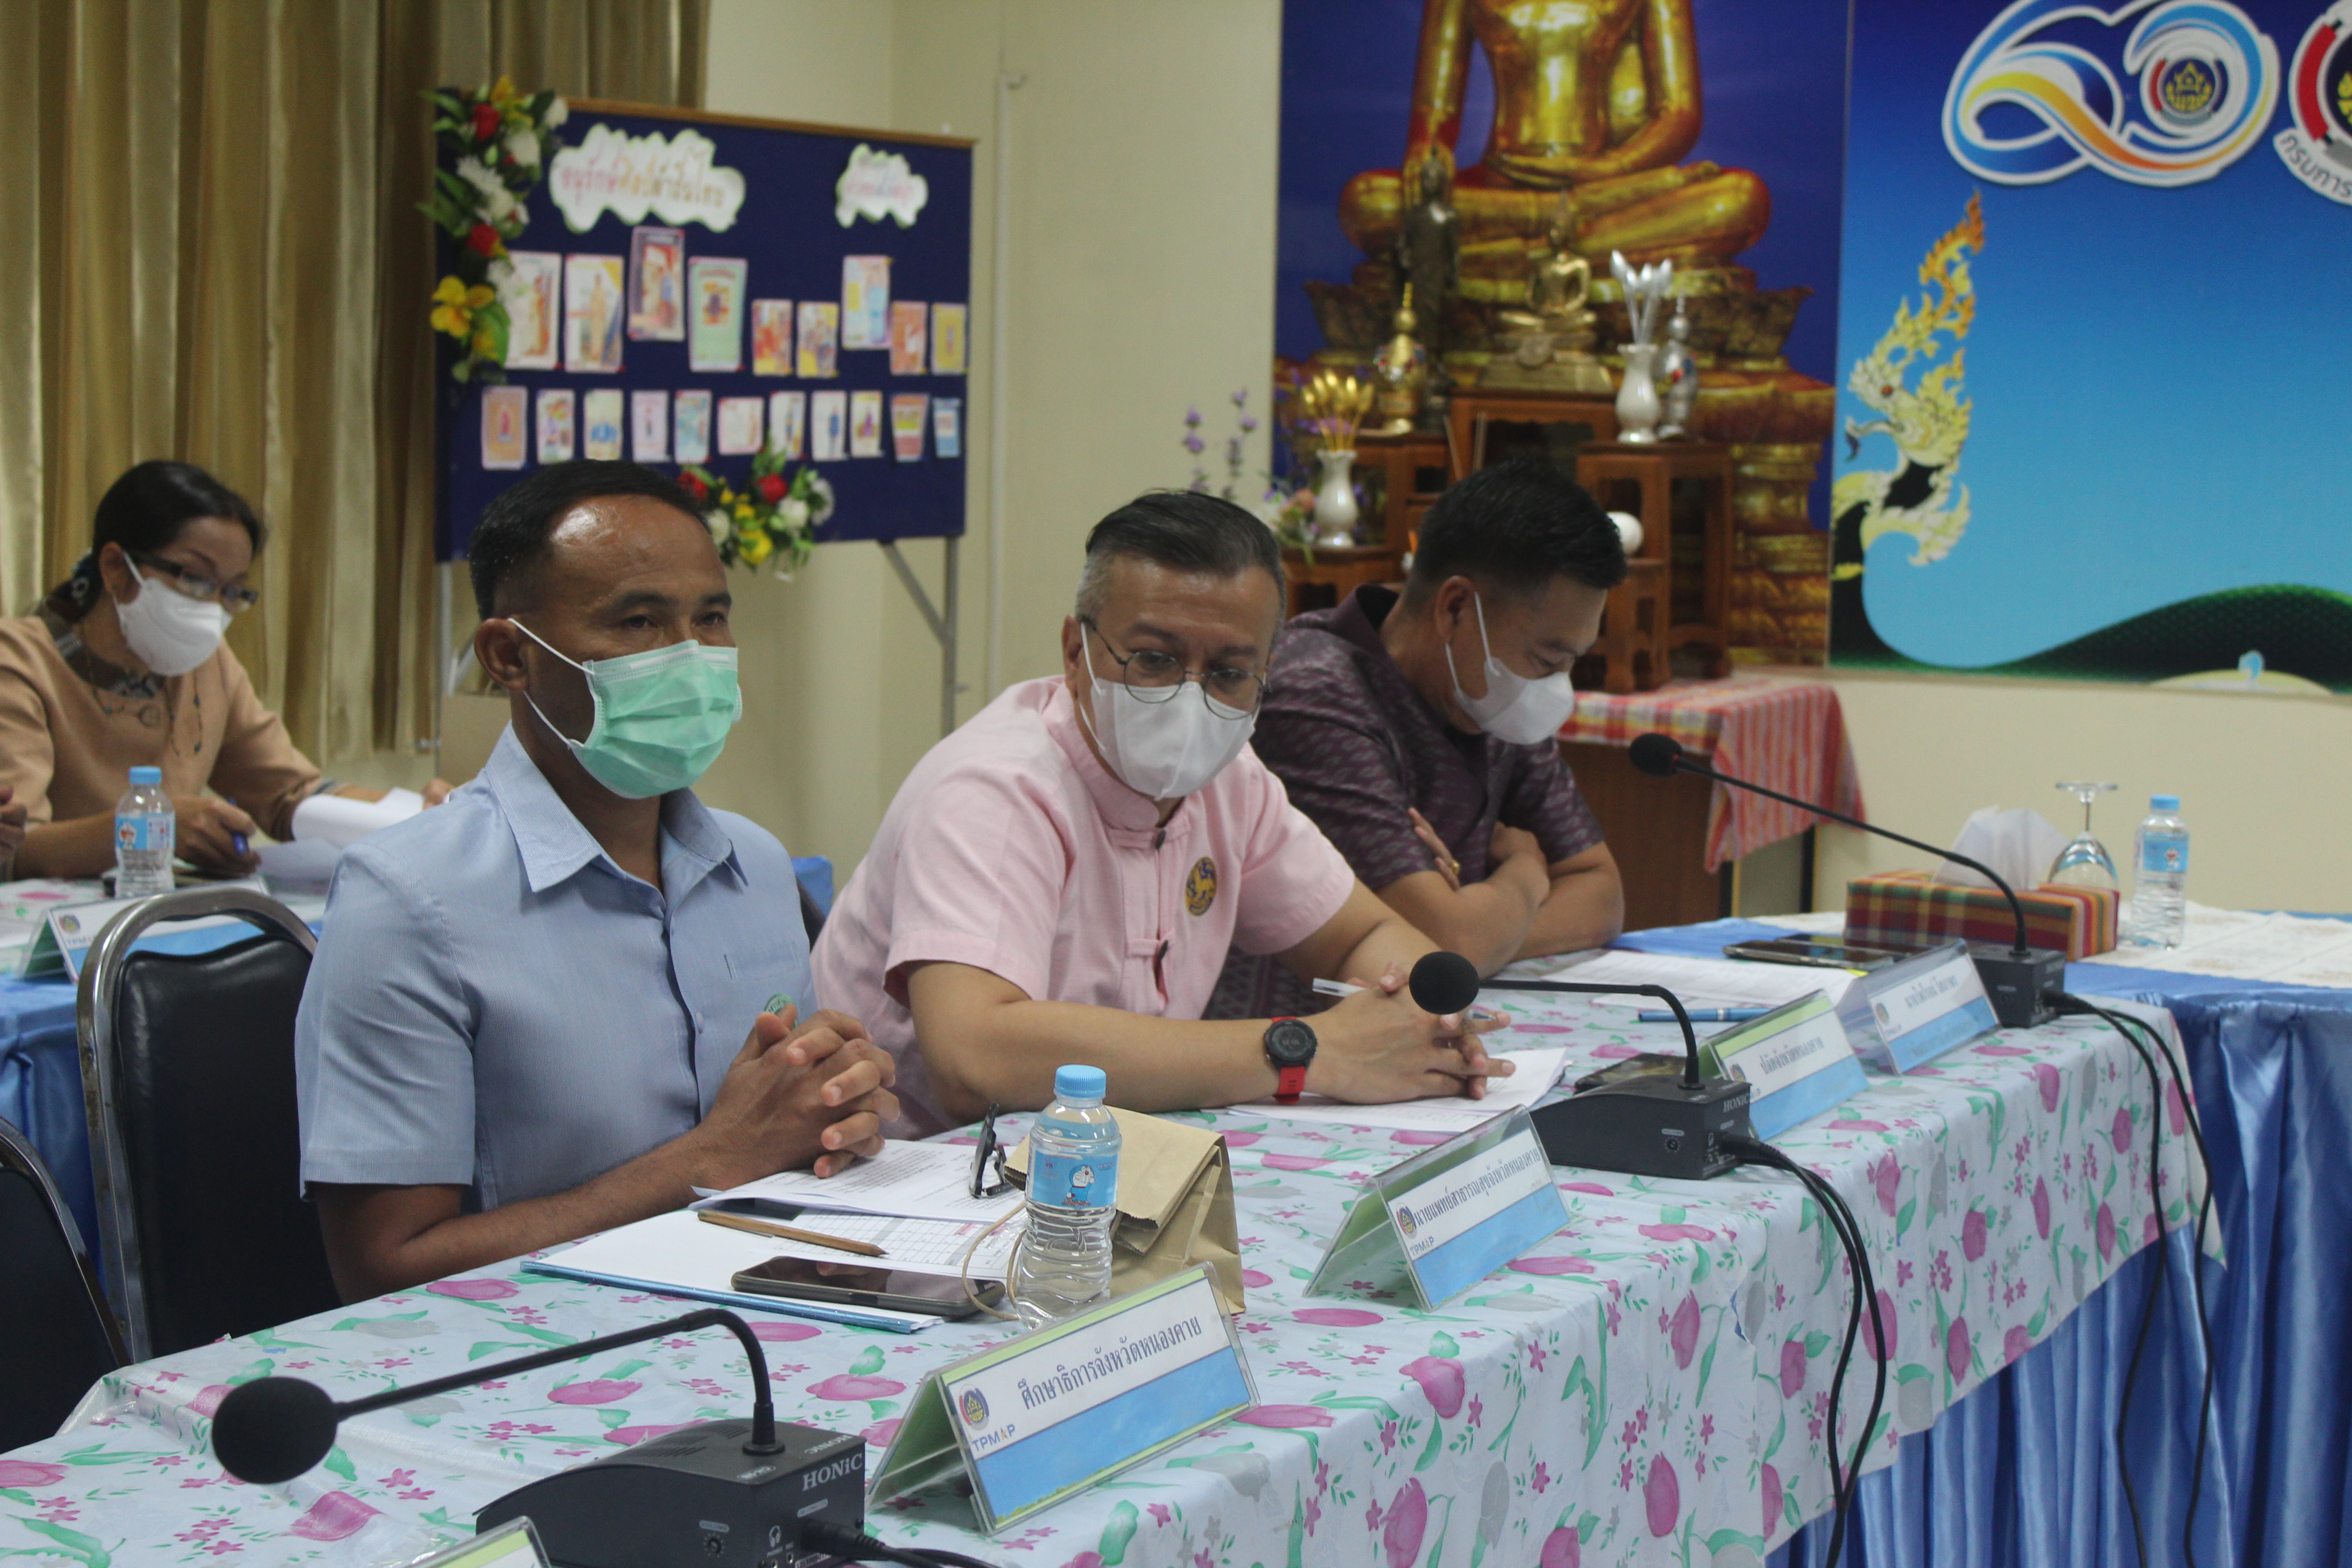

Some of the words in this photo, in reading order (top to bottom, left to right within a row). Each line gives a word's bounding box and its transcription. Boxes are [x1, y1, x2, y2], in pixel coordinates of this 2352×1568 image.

[1413, 1147, 1542, 1227] นายแพทย์สาธารณสุขจังหวัดหนองคาย
[1018, 1316, 1202, 1410] ศึกษาธิการจังหวัดหนองคาย
[972, 1424, 1016, 1452] TPMAP
